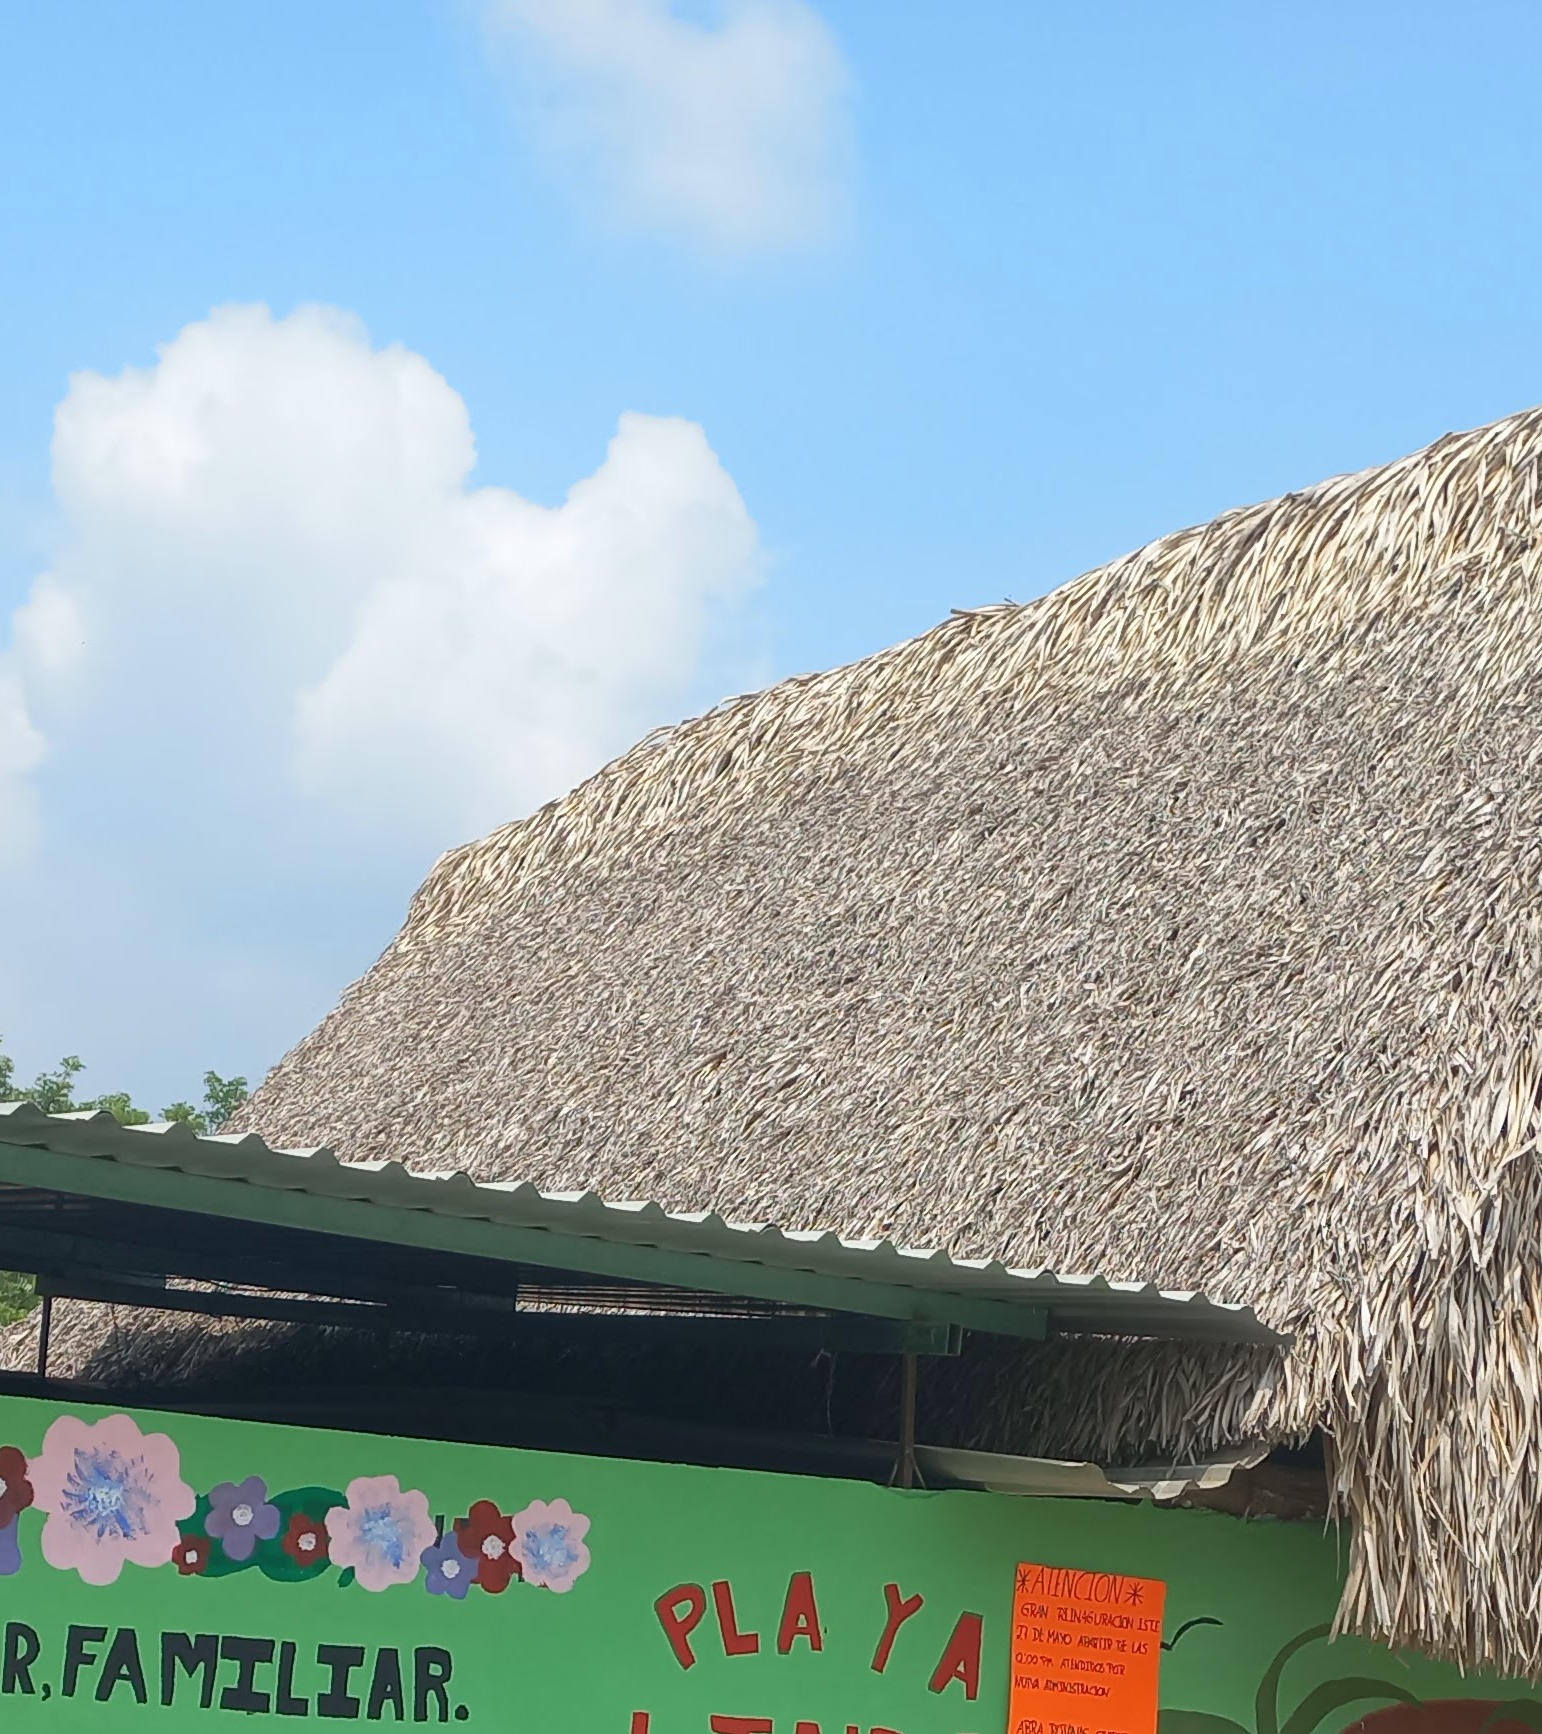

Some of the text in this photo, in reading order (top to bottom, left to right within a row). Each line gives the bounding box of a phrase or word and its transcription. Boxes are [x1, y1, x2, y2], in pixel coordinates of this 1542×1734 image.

[1021, 1602, 1049, 1619] GRAN
[1137, 1617, 1161, 1633] ESTE
[1047, 1630, 1072, 1646] MAYO
[1131, 1641, 1149, 1655] LAS
